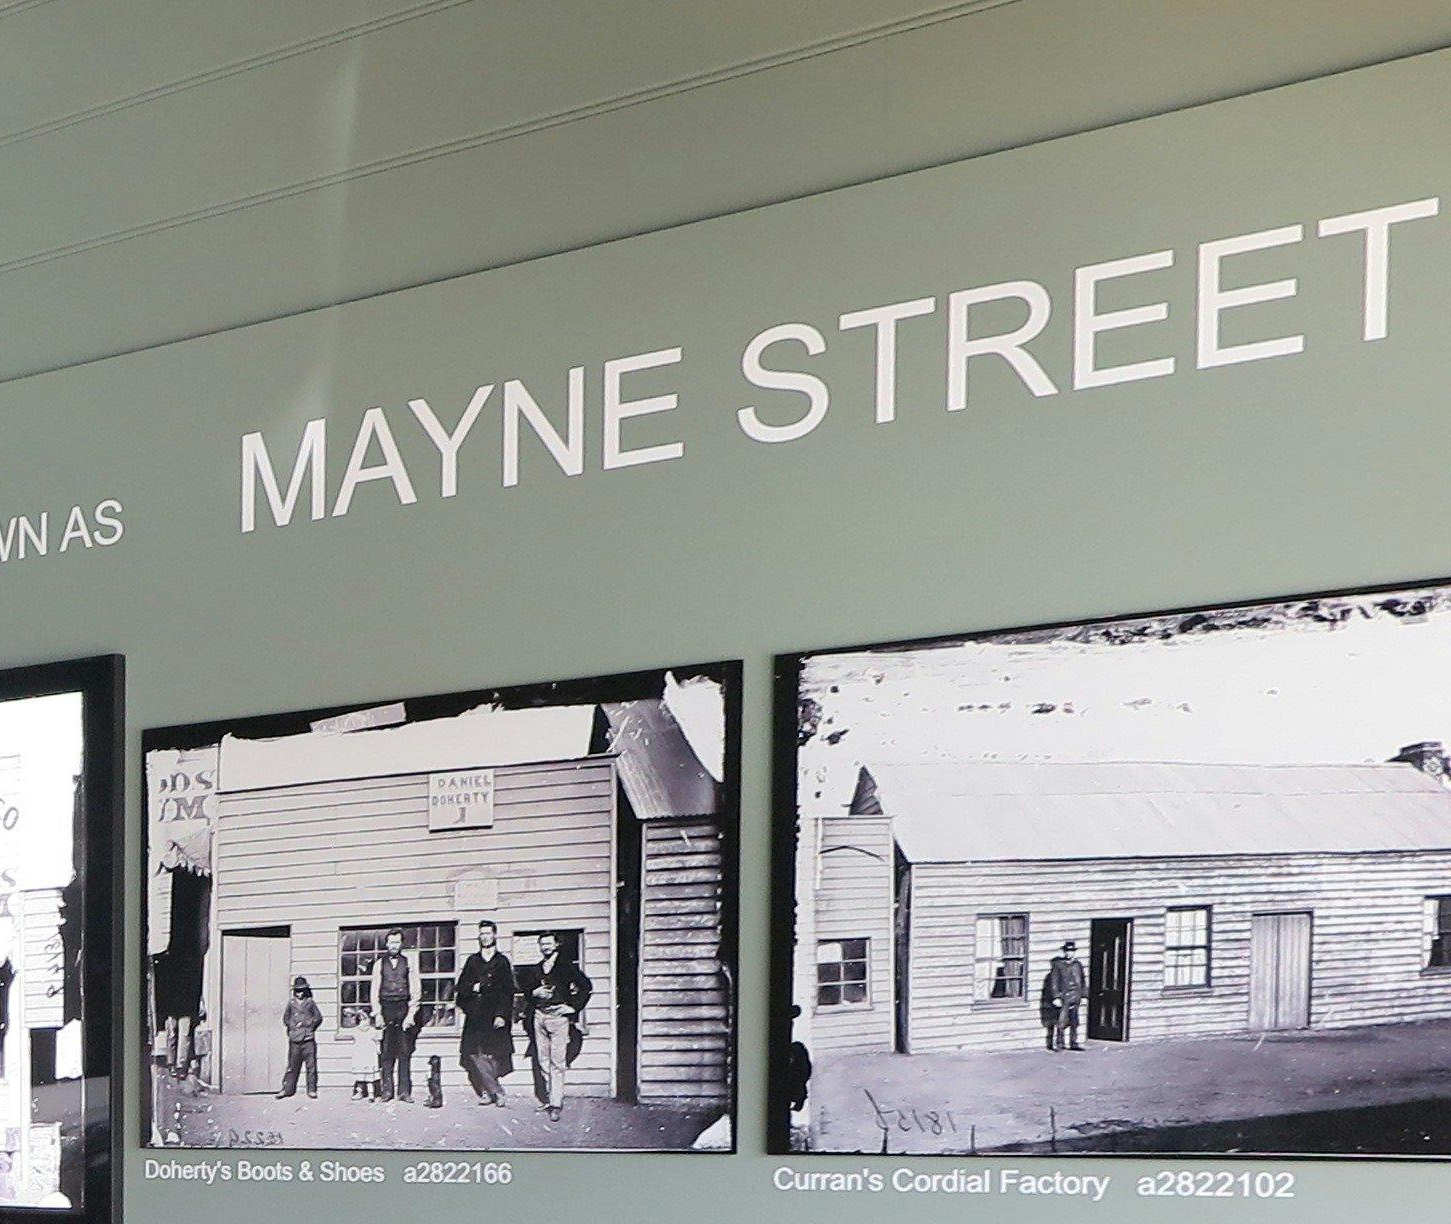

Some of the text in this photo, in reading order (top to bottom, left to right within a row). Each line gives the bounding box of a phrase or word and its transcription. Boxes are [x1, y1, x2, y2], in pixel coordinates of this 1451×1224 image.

[241, 196, 1440, 533] MAYNE STREET
[59, 499, 124, 552] AS
[438, 775, 492, 788] DANIEL
[432, 791, 489, 806] DOHERTY
[144, 1159, 513, 1185] Doherty's Boots & Shoes a2822166
[773, 1165, 1296, 1201] Curran's Cordial Factory a2822102
